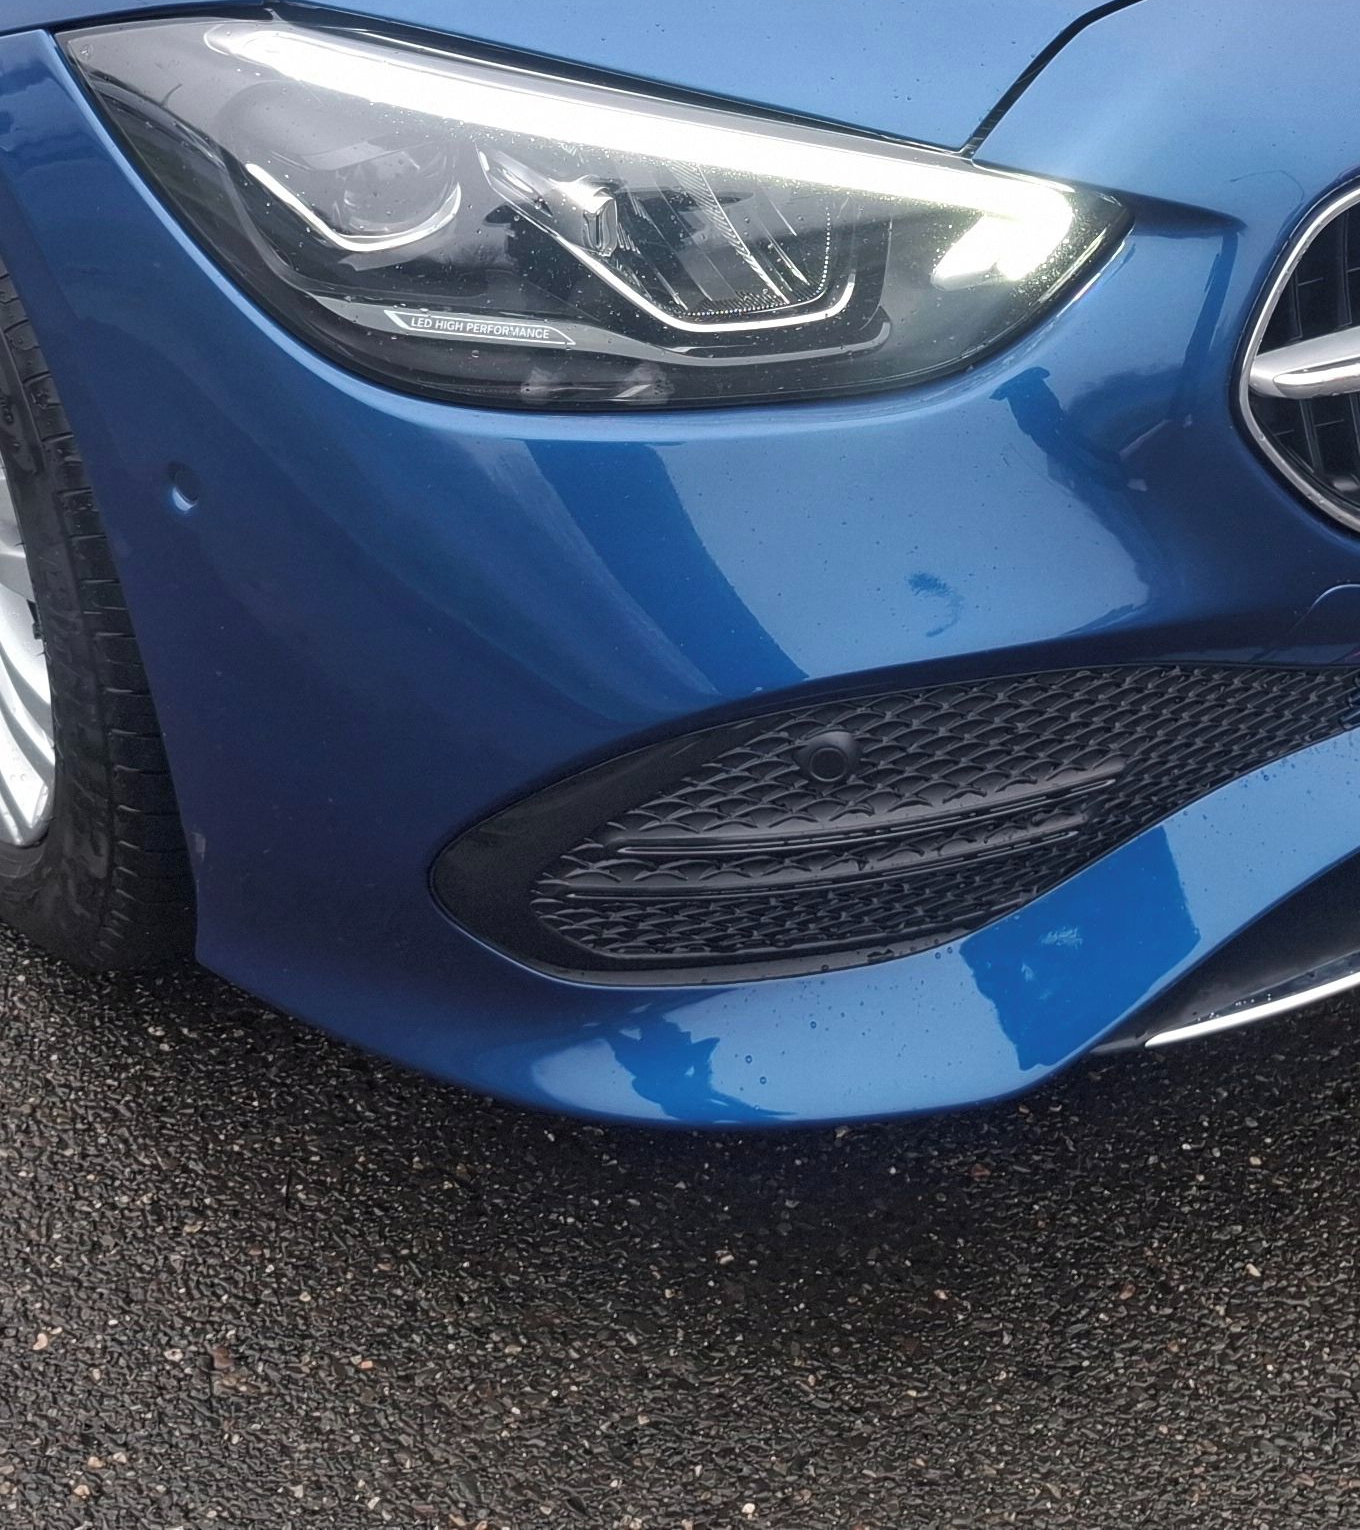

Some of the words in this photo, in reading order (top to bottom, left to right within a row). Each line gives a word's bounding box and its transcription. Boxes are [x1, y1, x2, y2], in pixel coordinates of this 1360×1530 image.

[411, 317, 433, 328] LED
[435, 319, 464, 332] HIGH
[466, 322, 550, 339] PERFORMANCE
